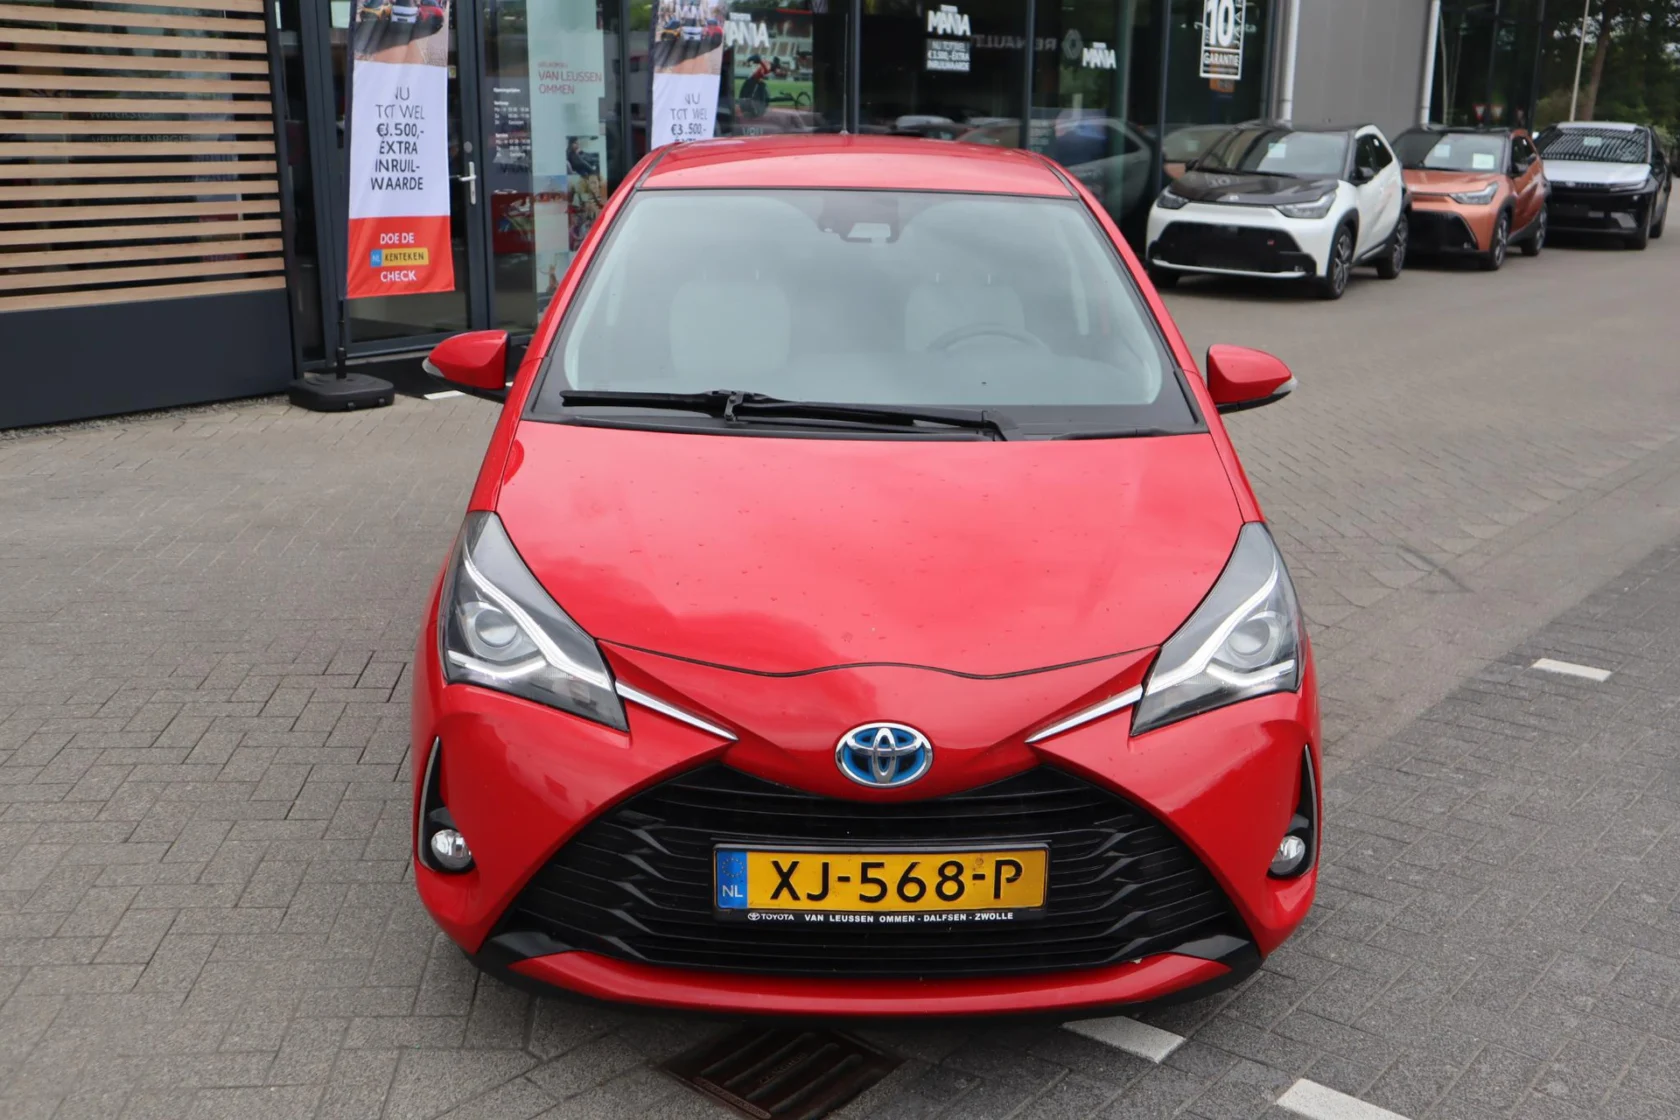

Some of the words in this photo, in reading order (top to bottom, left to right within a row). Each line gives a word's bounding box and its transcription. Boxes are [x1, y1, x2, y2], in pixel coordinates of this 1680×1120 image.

[928, 10, 971, 37] MANIA
[1203, 52, 1240, 66] GARANTIE
[538, 70, 559, 81] VAN
[560, 71, 602, 82] LEUSSEN
[399, 105, 425, 120] WEL
[379, 140, 418, 155] EXTRA
[375, 158, 421, 173] INRUIL-
[370, 176, 424, 191] WAARDE
[380, 233, 400, 244] DOE
[401, 233, 415, 244] DE
[385, 251, 424, 261] KENTEKEN
[380, 270, 416, 282] CHECK
[769, 858, 1024, 903] XJ-568-P
[721, 884, 744, 899] NL
[761, 913, 795, 921] TOYOTA
[804, 914, 824, 922] VAN
[829, 914, 874, 923] LEUSSEN
[879, 914, 915, 923] OMMEN
[923, 913, 967, 923] DALFSEN
[974, 911, 1014, 921] ZWOLLE
